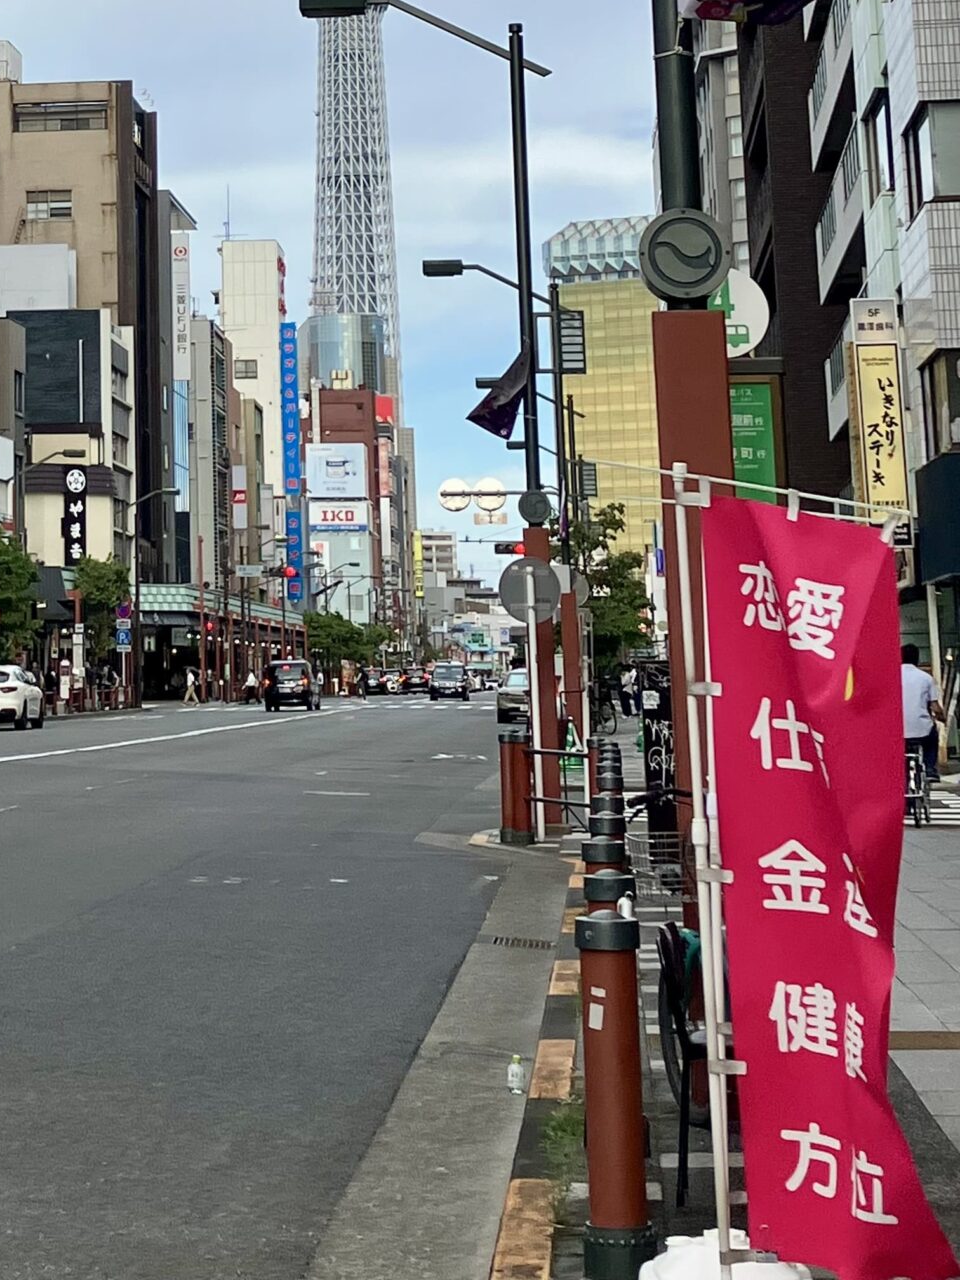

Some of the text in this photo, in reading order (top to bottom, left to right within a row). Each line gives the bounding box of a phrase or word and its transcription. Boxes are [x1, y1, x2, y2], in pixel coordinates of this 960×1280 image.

[868, 308, 881, 317] 5F
[867, 423, 886, 487] ステーキ
[738, 560, 845, 660] 恋愛
